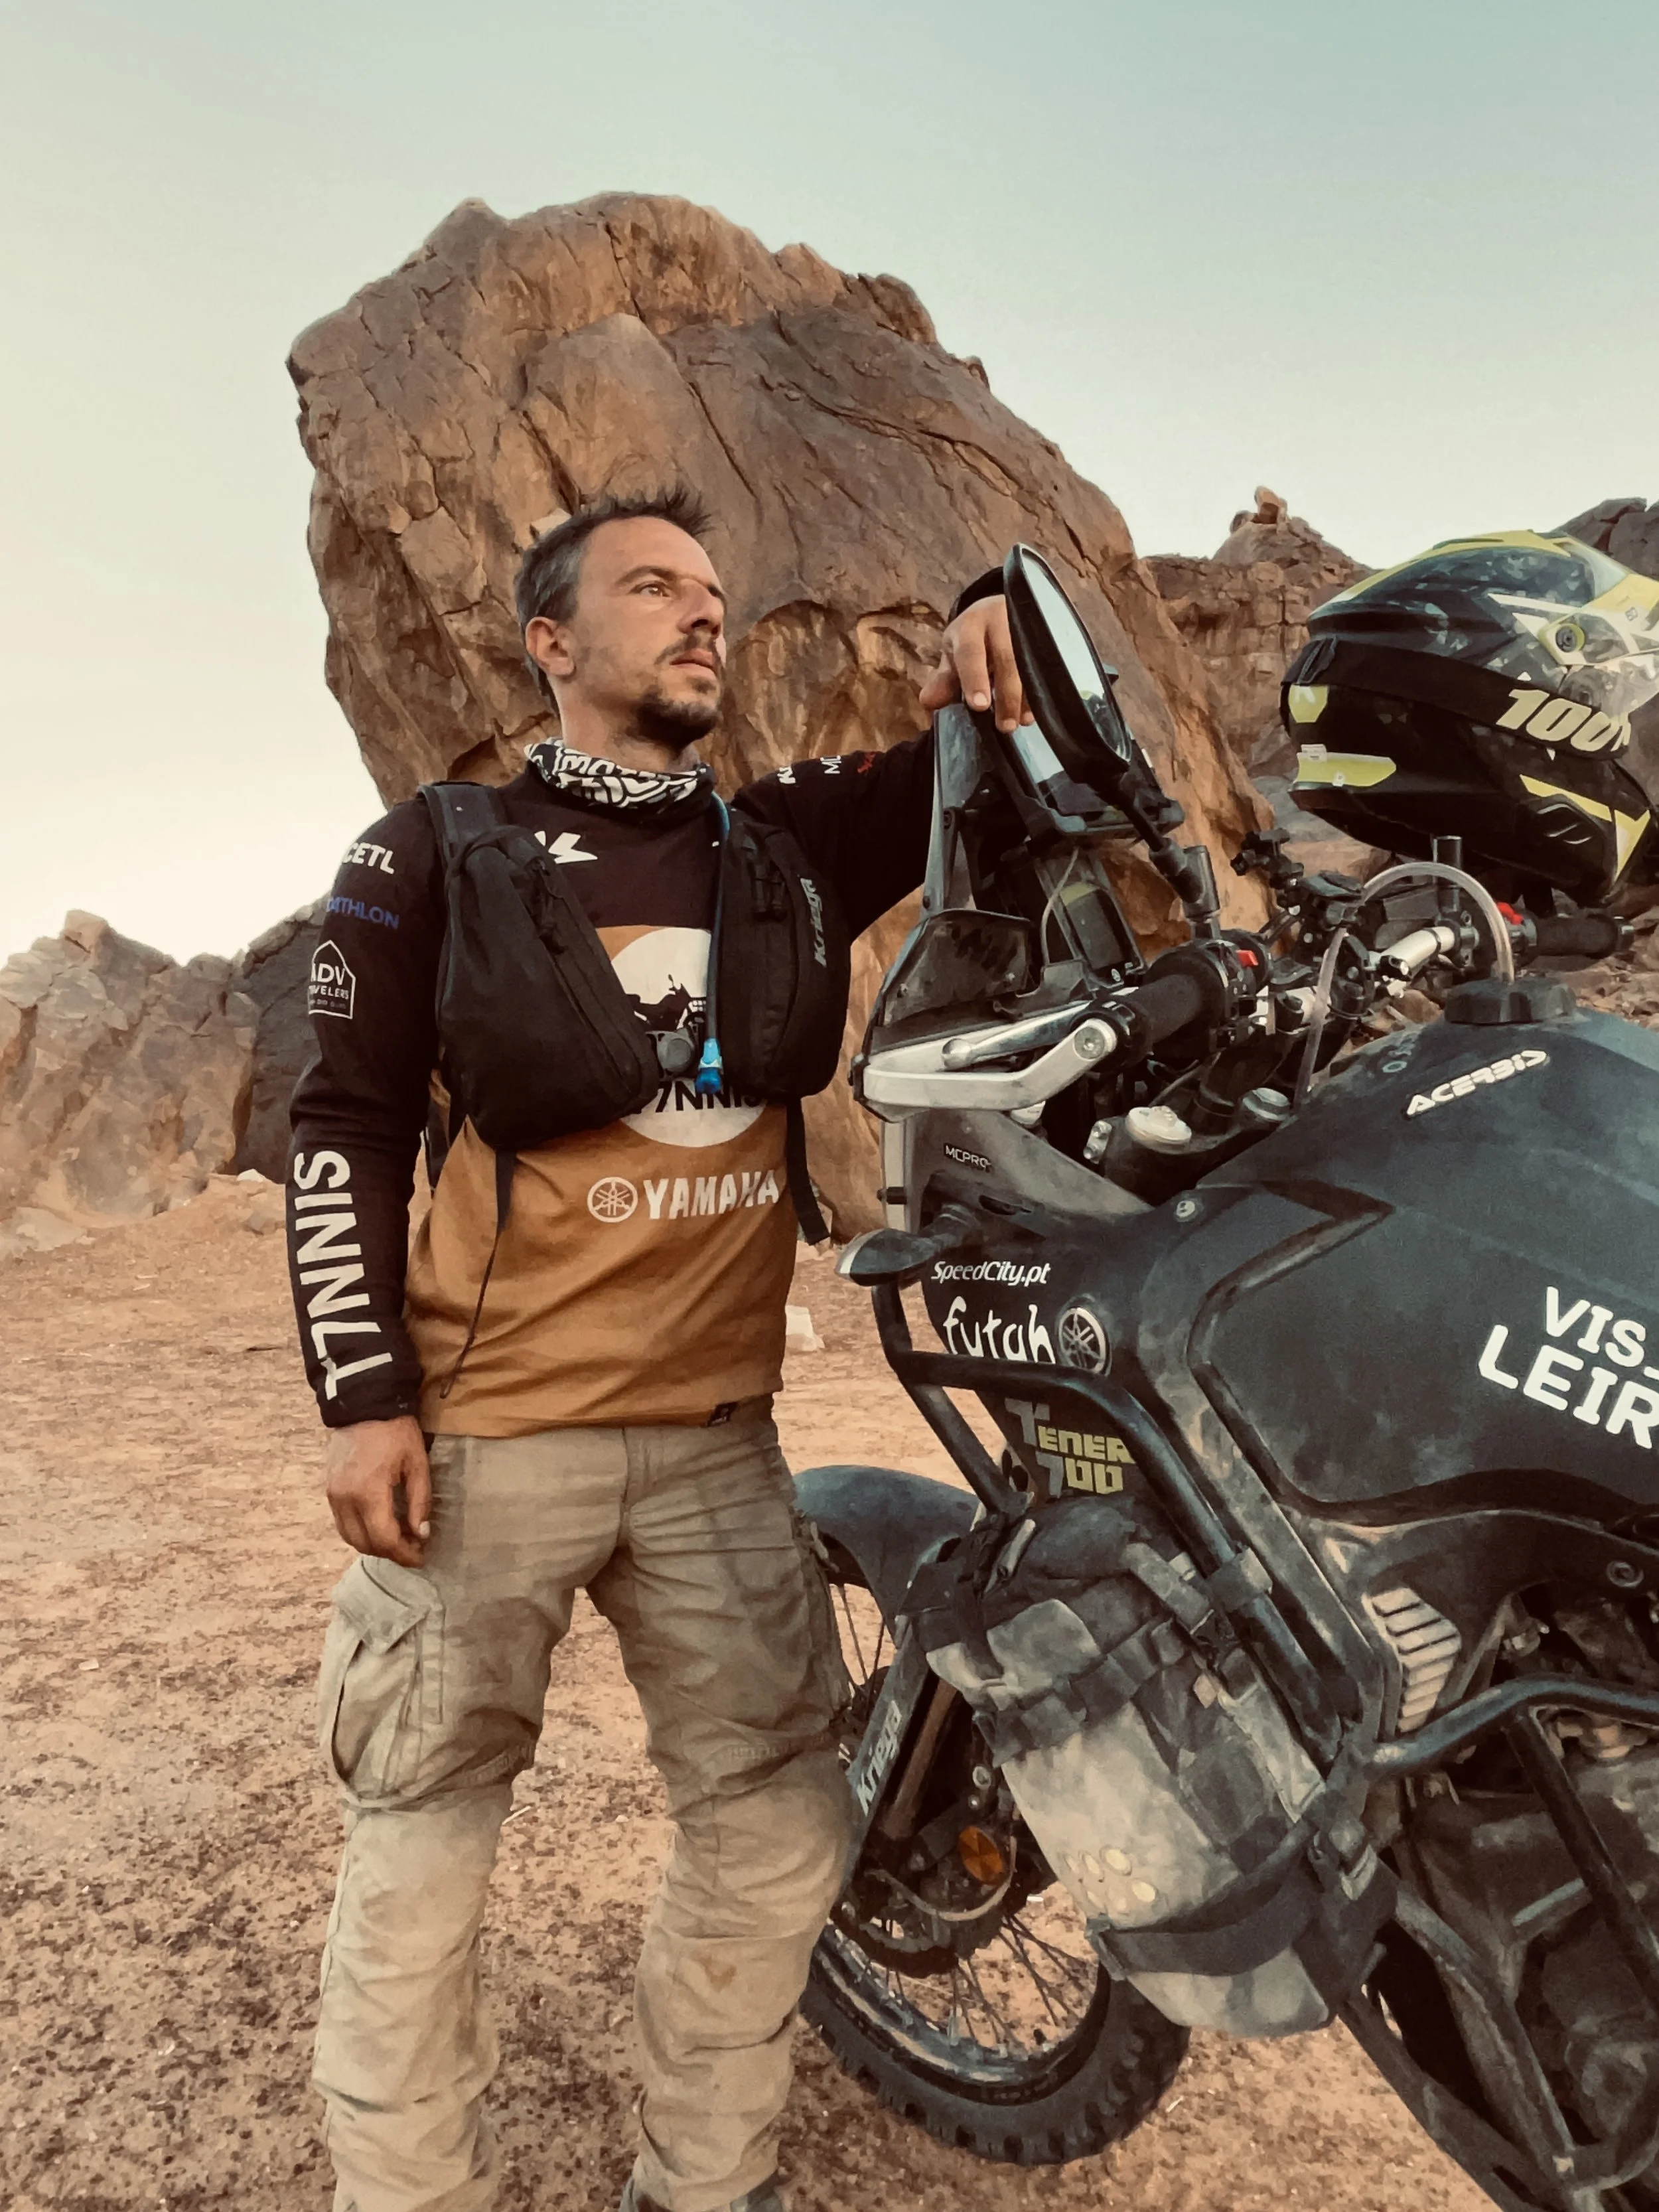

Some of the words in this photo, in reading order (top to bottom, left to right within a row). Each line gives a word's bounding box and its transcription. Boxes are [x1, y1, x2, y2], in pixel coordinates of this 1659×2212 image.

[642, 1169, 780, 1220] YAMAHA
[931, 1261, 1051, 1287] SpeedCity.pt
[1546, 1286, 1659, 1381] VIS
